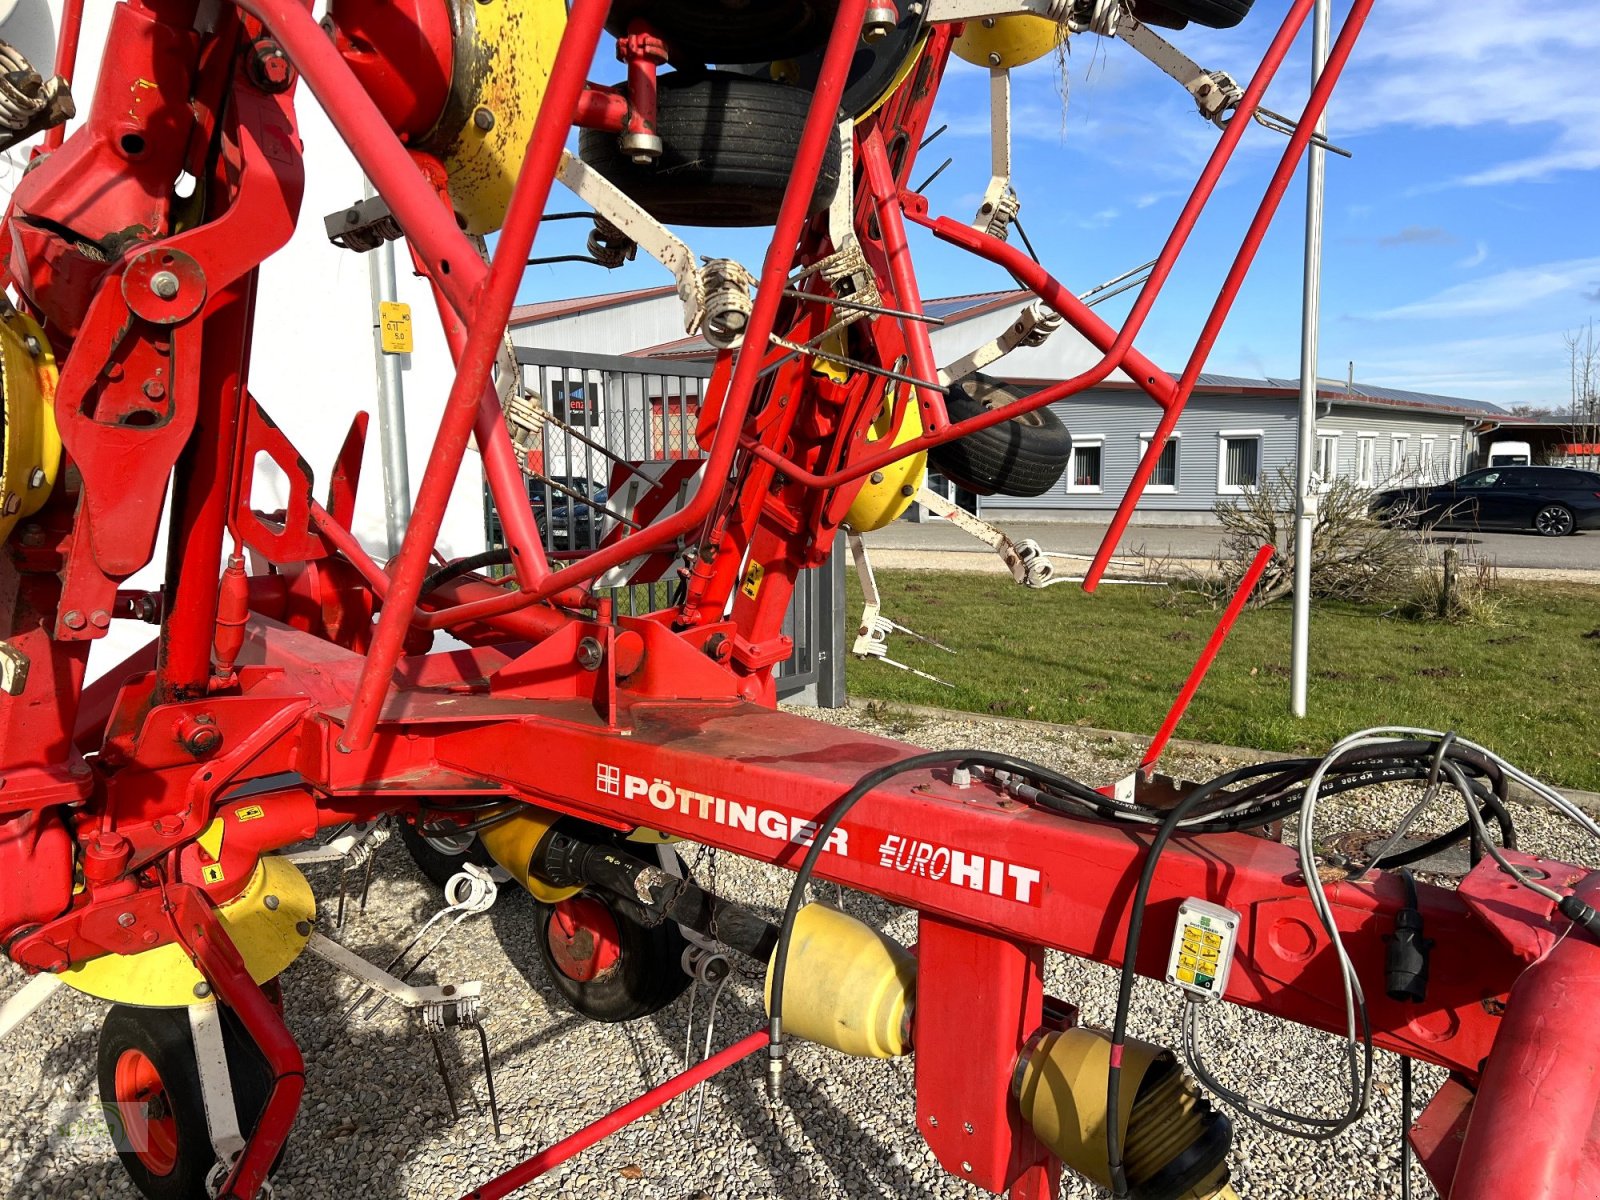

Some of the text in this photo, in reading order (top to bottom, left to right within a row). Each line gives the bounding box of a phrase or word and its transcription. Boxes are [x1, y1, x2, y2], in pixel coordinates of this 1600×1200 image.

[1321, 782, 1334, 791] EN
[1286, 793, 1302, 803] 2SC
[623, 774, 849, 857] PÖTTINGER
